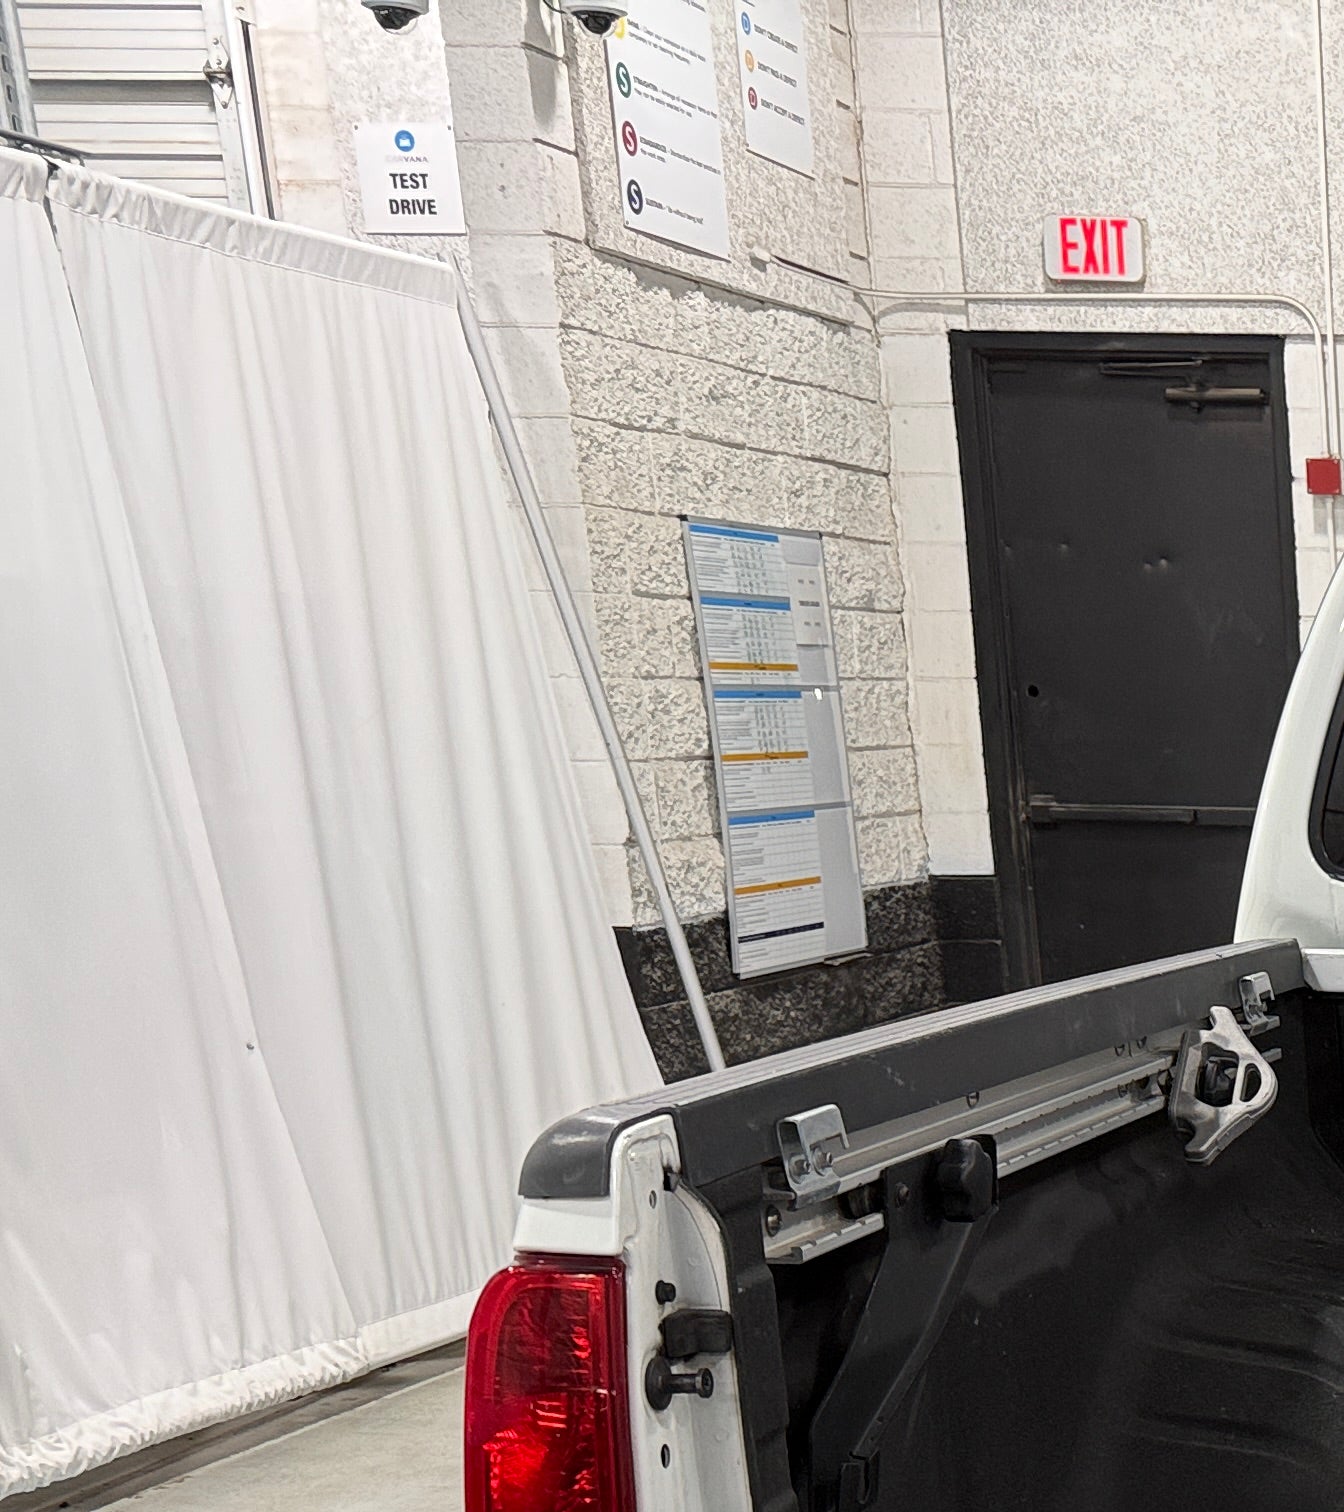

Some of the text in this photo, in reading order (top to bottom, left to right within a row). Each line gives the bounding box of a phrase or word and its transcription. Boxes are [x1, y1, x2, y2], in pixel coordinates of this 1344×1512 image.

[388, 173, 428, 190] TEST
[388, 198, 438, 215] DRIVE
[1059, 217, 1129, 276] EXIT
